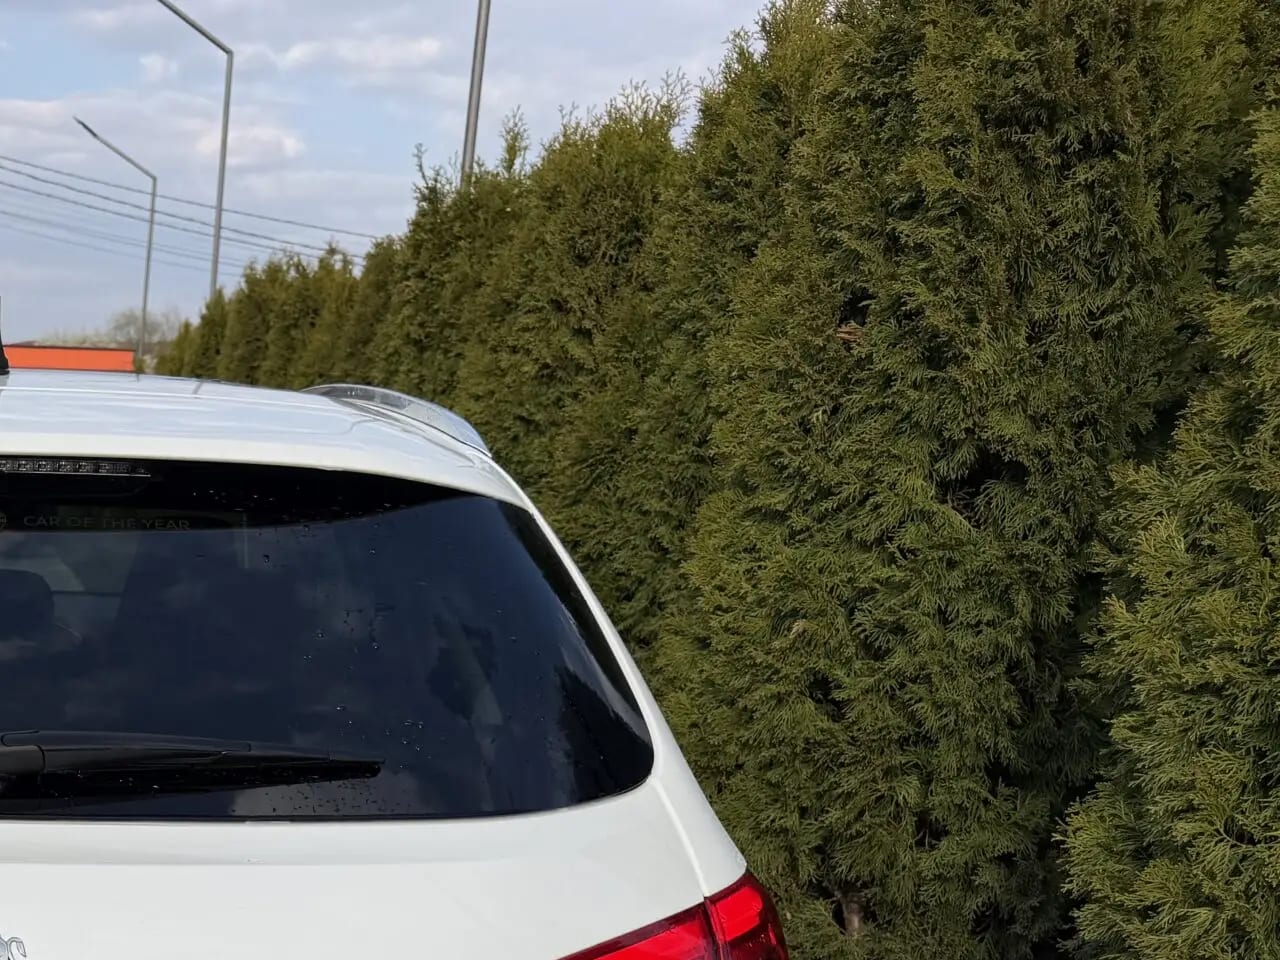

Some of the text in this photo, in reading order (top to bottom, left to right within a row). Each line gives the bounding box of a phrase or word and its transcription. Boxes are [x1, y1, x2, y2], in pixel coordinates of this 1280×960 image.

[23, 515, 60, 527] CAR
[102, 517, 136, 529] THE
[141, 518, 192, 531] YEAR
